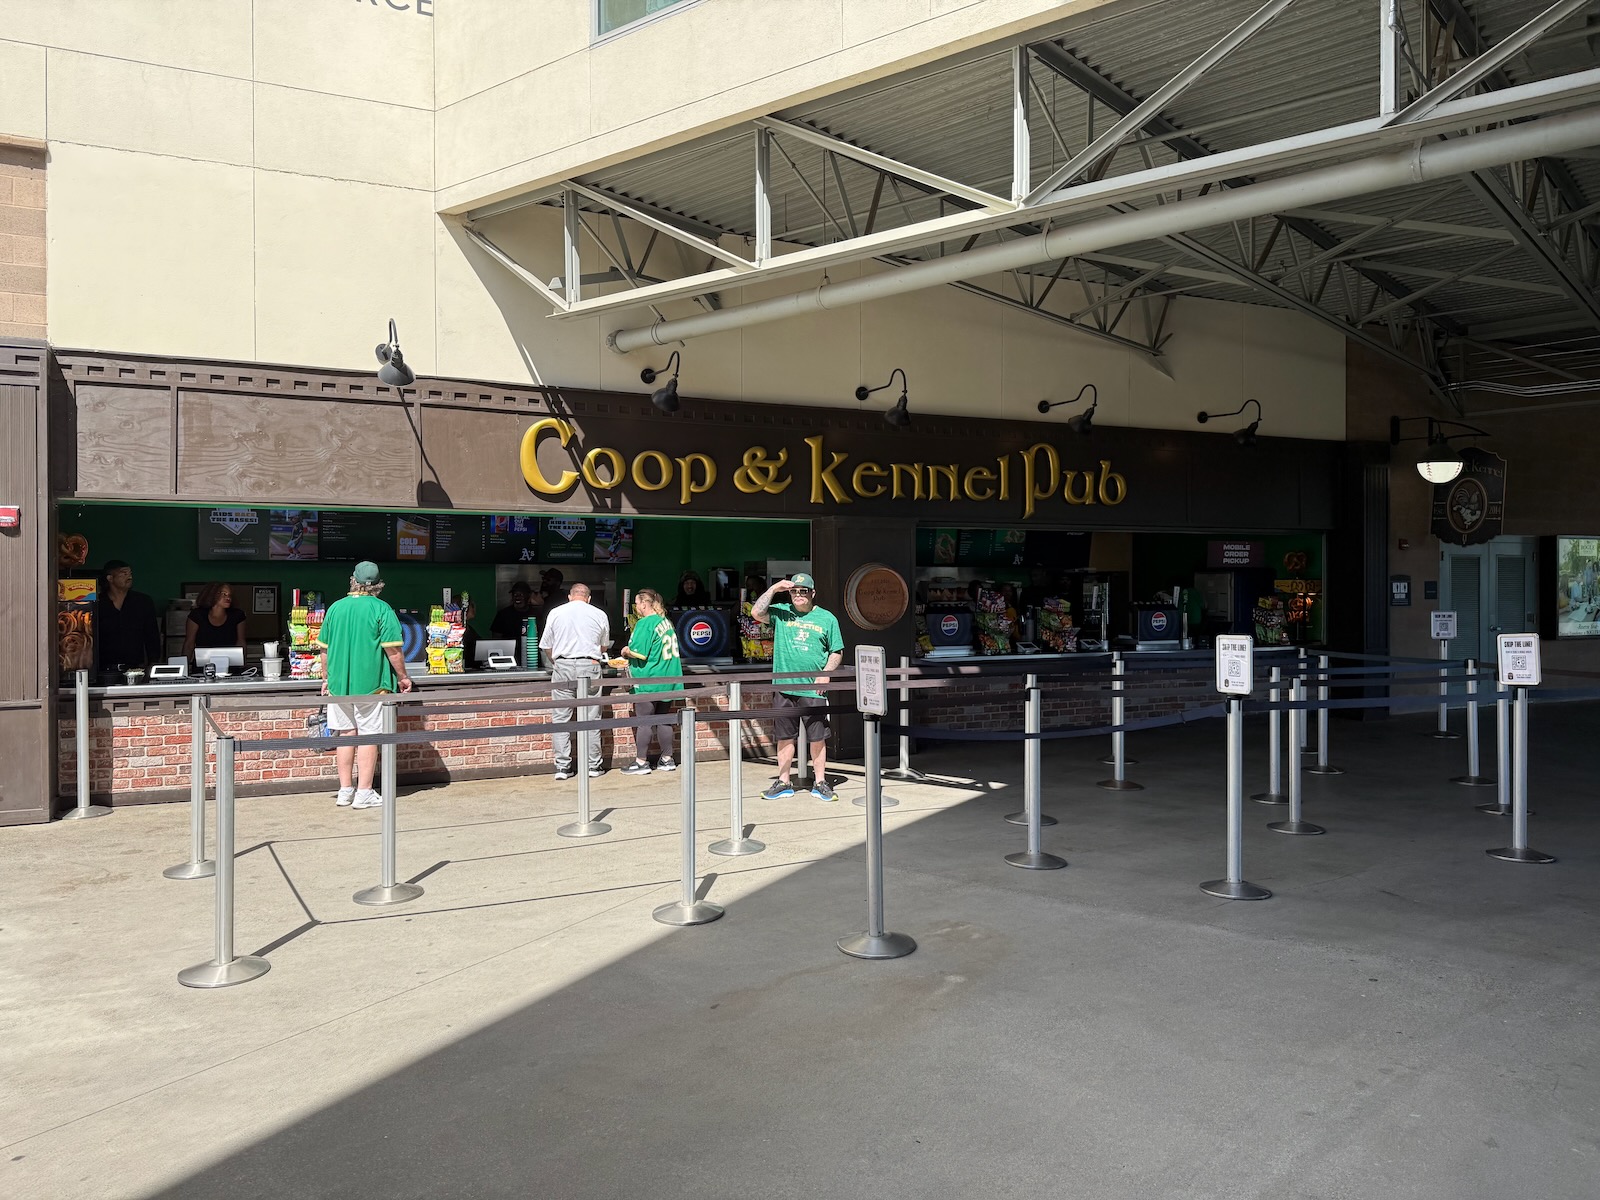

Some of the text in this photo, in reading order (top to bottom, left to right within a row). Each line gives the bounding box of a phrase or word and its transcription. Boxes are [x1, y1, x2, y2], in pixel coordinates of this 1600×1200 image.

[519, 418, 718, 505] Coop
[732, 445, 793, 496] &
[1018, 442, 1128, 520] Pub
[399, 537, 418, 545] COLD
[1522, 640, 1533, 648] LINE!
